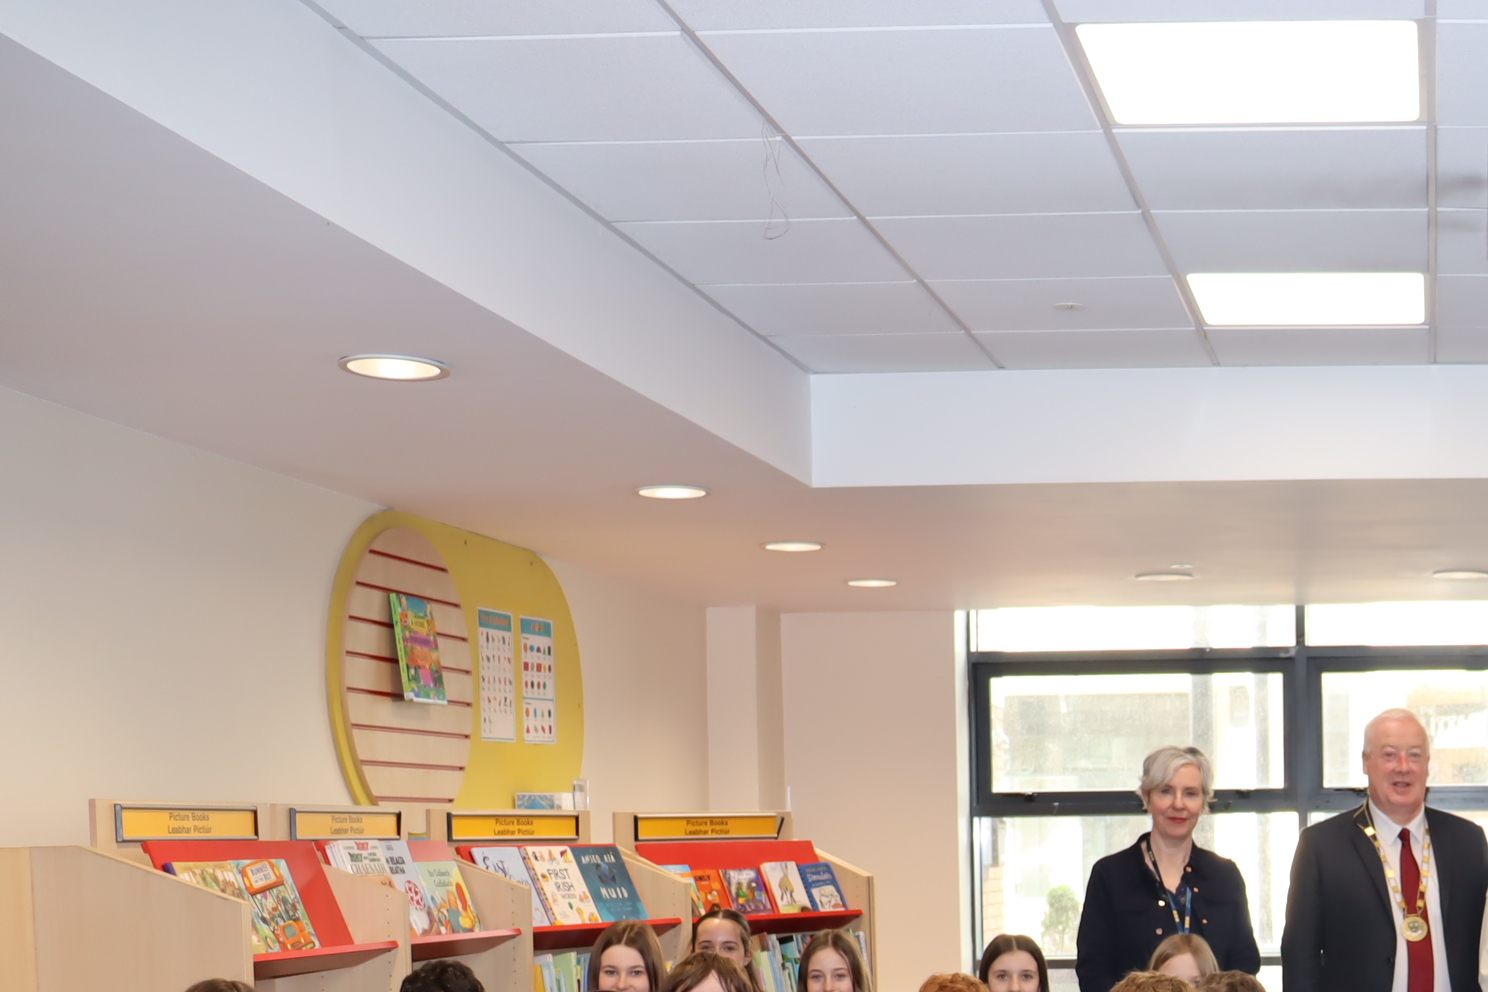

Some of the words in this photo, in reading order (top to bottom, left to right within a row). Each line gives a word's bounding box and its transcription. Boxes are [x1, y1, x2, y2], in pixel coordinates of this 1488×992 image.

[168, 812, 190, 821] Picture
[191, 812, 210, 821] Books
[331, 815, 348, 823] Picture
[348, 815, 363, 823] Books
[495, 818, 515, 826] Picture
[516, 818, 534, 826] Books
[686, 819, 708, 827] Picture
[709, 819, 728, 827] Books
[167, 825, 192, 834] Leabhar
[493, 828, 516, 836] Leabhar
[684, 828, 709, 836] Leabhar
[547, 868, 571, 880] FIRST
[554, 882, 576, 892] IRISH
[600, 887, 629, 900] MUID
